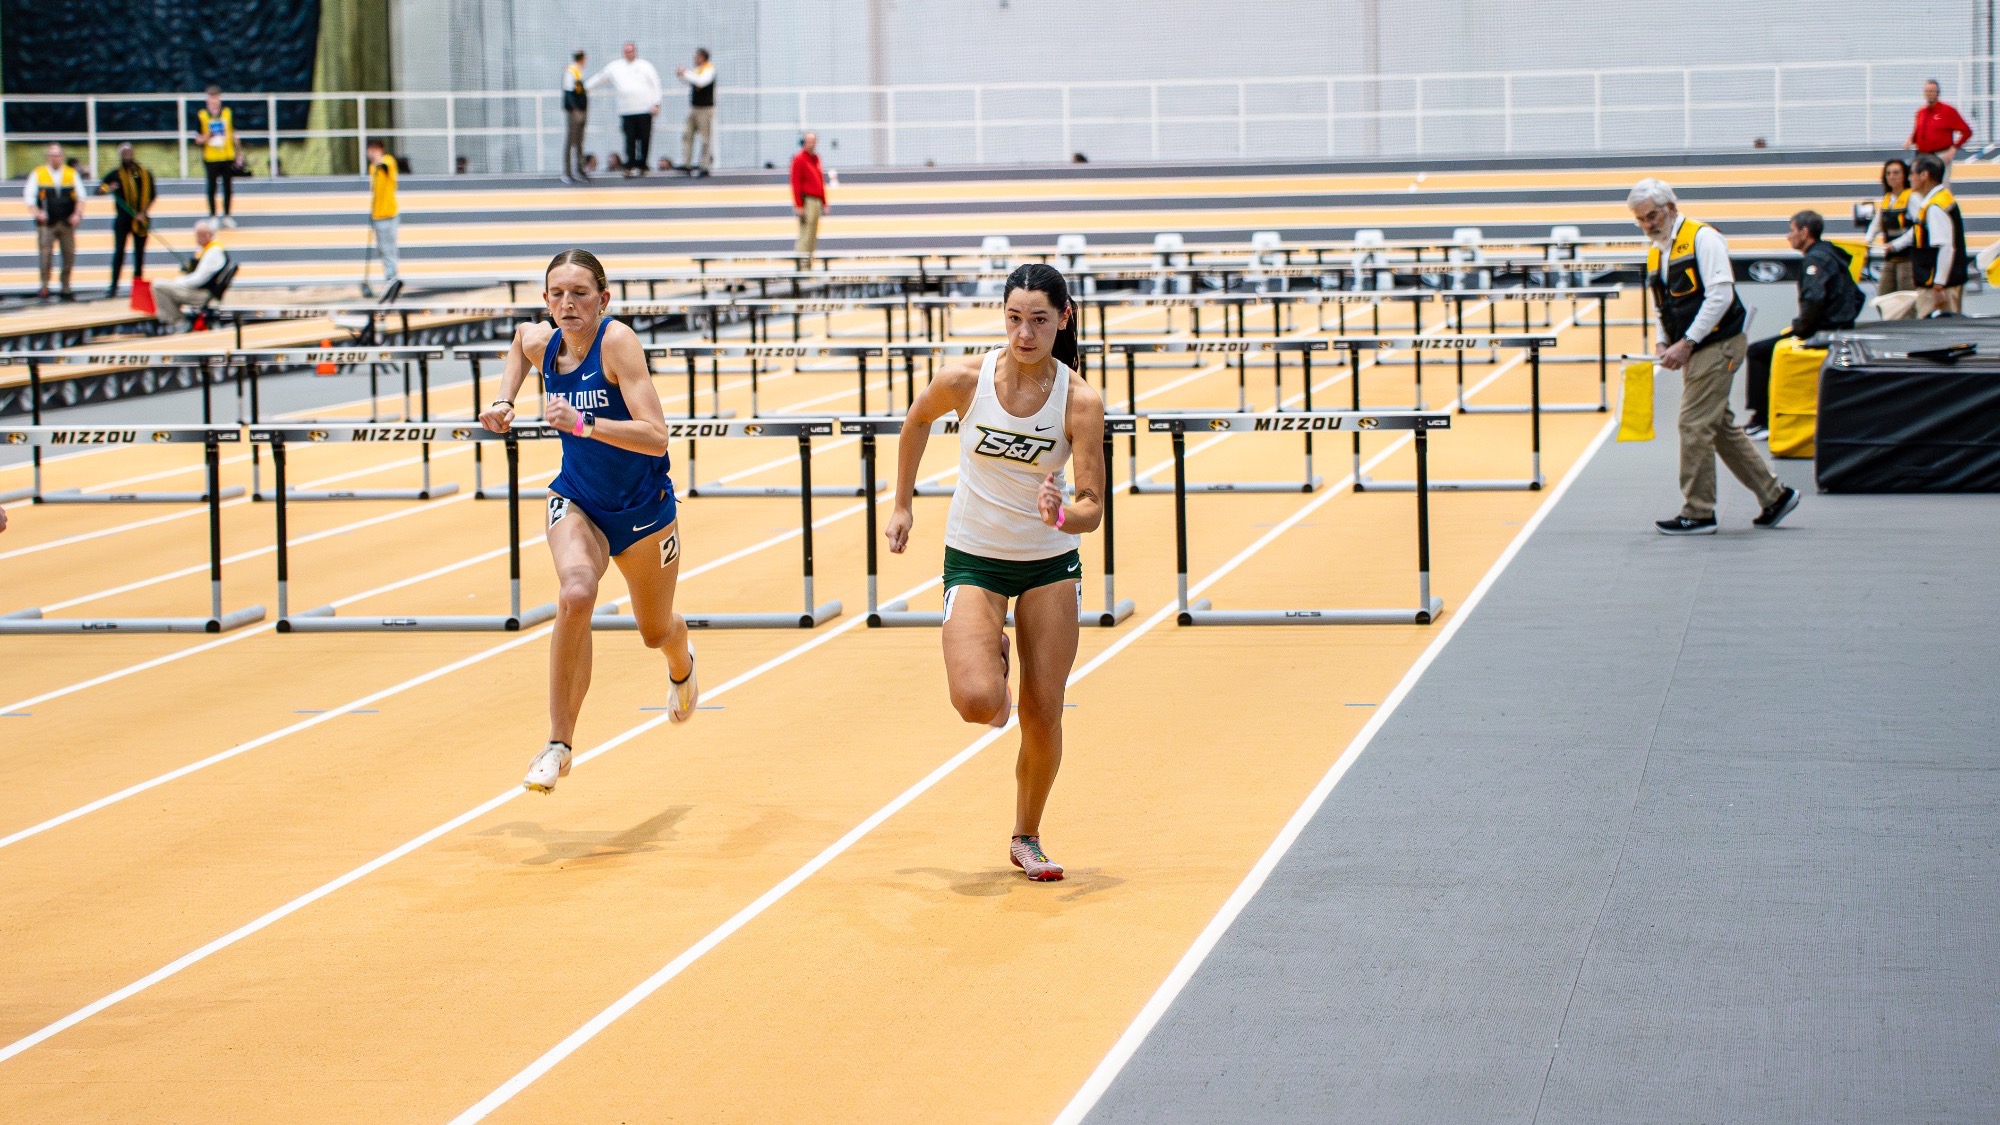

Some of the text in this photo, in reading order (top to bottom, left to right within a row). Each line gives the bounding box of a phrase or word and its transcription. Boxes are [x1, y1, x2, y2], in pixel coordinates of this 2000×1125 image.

[1186, 342, 1250, 352] MIZZOU
[1411, 339, 1477, 349] MIZZOU
[306, 352, 368, 362] MIZZOU
[744, 347, 807, 357] MIZZOU
[89, 355, 149, 365] MIZZOU
[569, 389, 610, 409] LOUIS
[1254, 417, 1342, 430] MIZZOU
[51, 431, 137, 444] MIZZOU
[352, 428, 436, 441] MIZZOU
[667, 424, 729, 438] ZZOU
[977, 429, 1052, 462] S&T
[549, 497, 564, 525] 2
[663, 535, 677, 565] 2
[686, 620, 709, 628] CS
